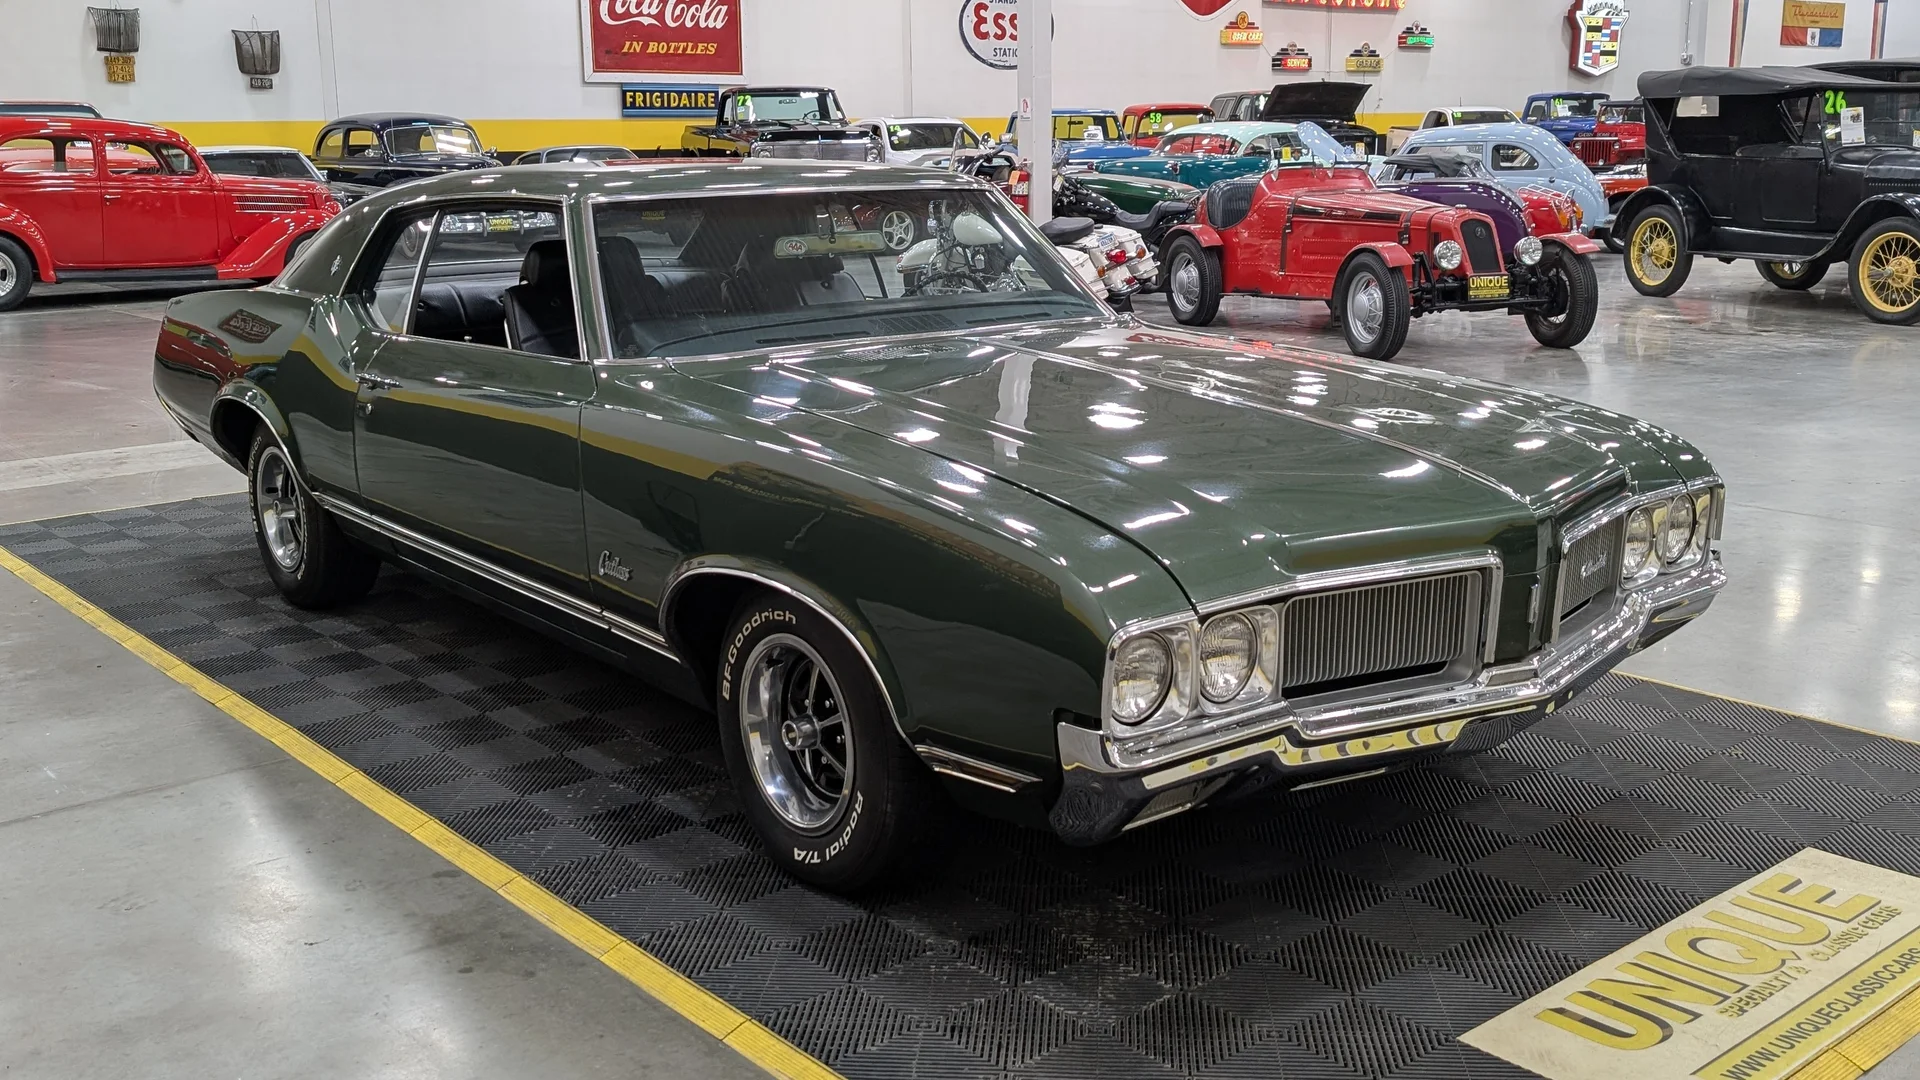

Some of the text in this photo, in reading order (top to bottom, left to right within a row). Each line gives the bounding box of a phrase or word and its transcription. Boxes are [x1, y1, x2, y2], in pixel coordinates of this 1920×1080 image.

[973, 2, 1018, 41] Ess
[621, 41, 717, 55] IN BOTTLES
[993, 47, 1018, 58] STATI
[626, 92, 716, 108] FRIGIDAIRE
[1825, 90, 1847, 114] 26
[1149, 112, 1162, 124] 58
[1470, 275, 1509, 288] UNIQUE
[599, 550, 632, 581] Cutlass
[722, 608, 797, 701] BFGoodrich
[793, 790, 864, 864] Radial T/A
[1533, 872, 1882, 1051] UNIQUE
[1715, 970, 1798, 1018] SPECIALTY
[1807, 925, 1869, 961] CLASSIC
[1858, 905, 1902, 929] CARS
